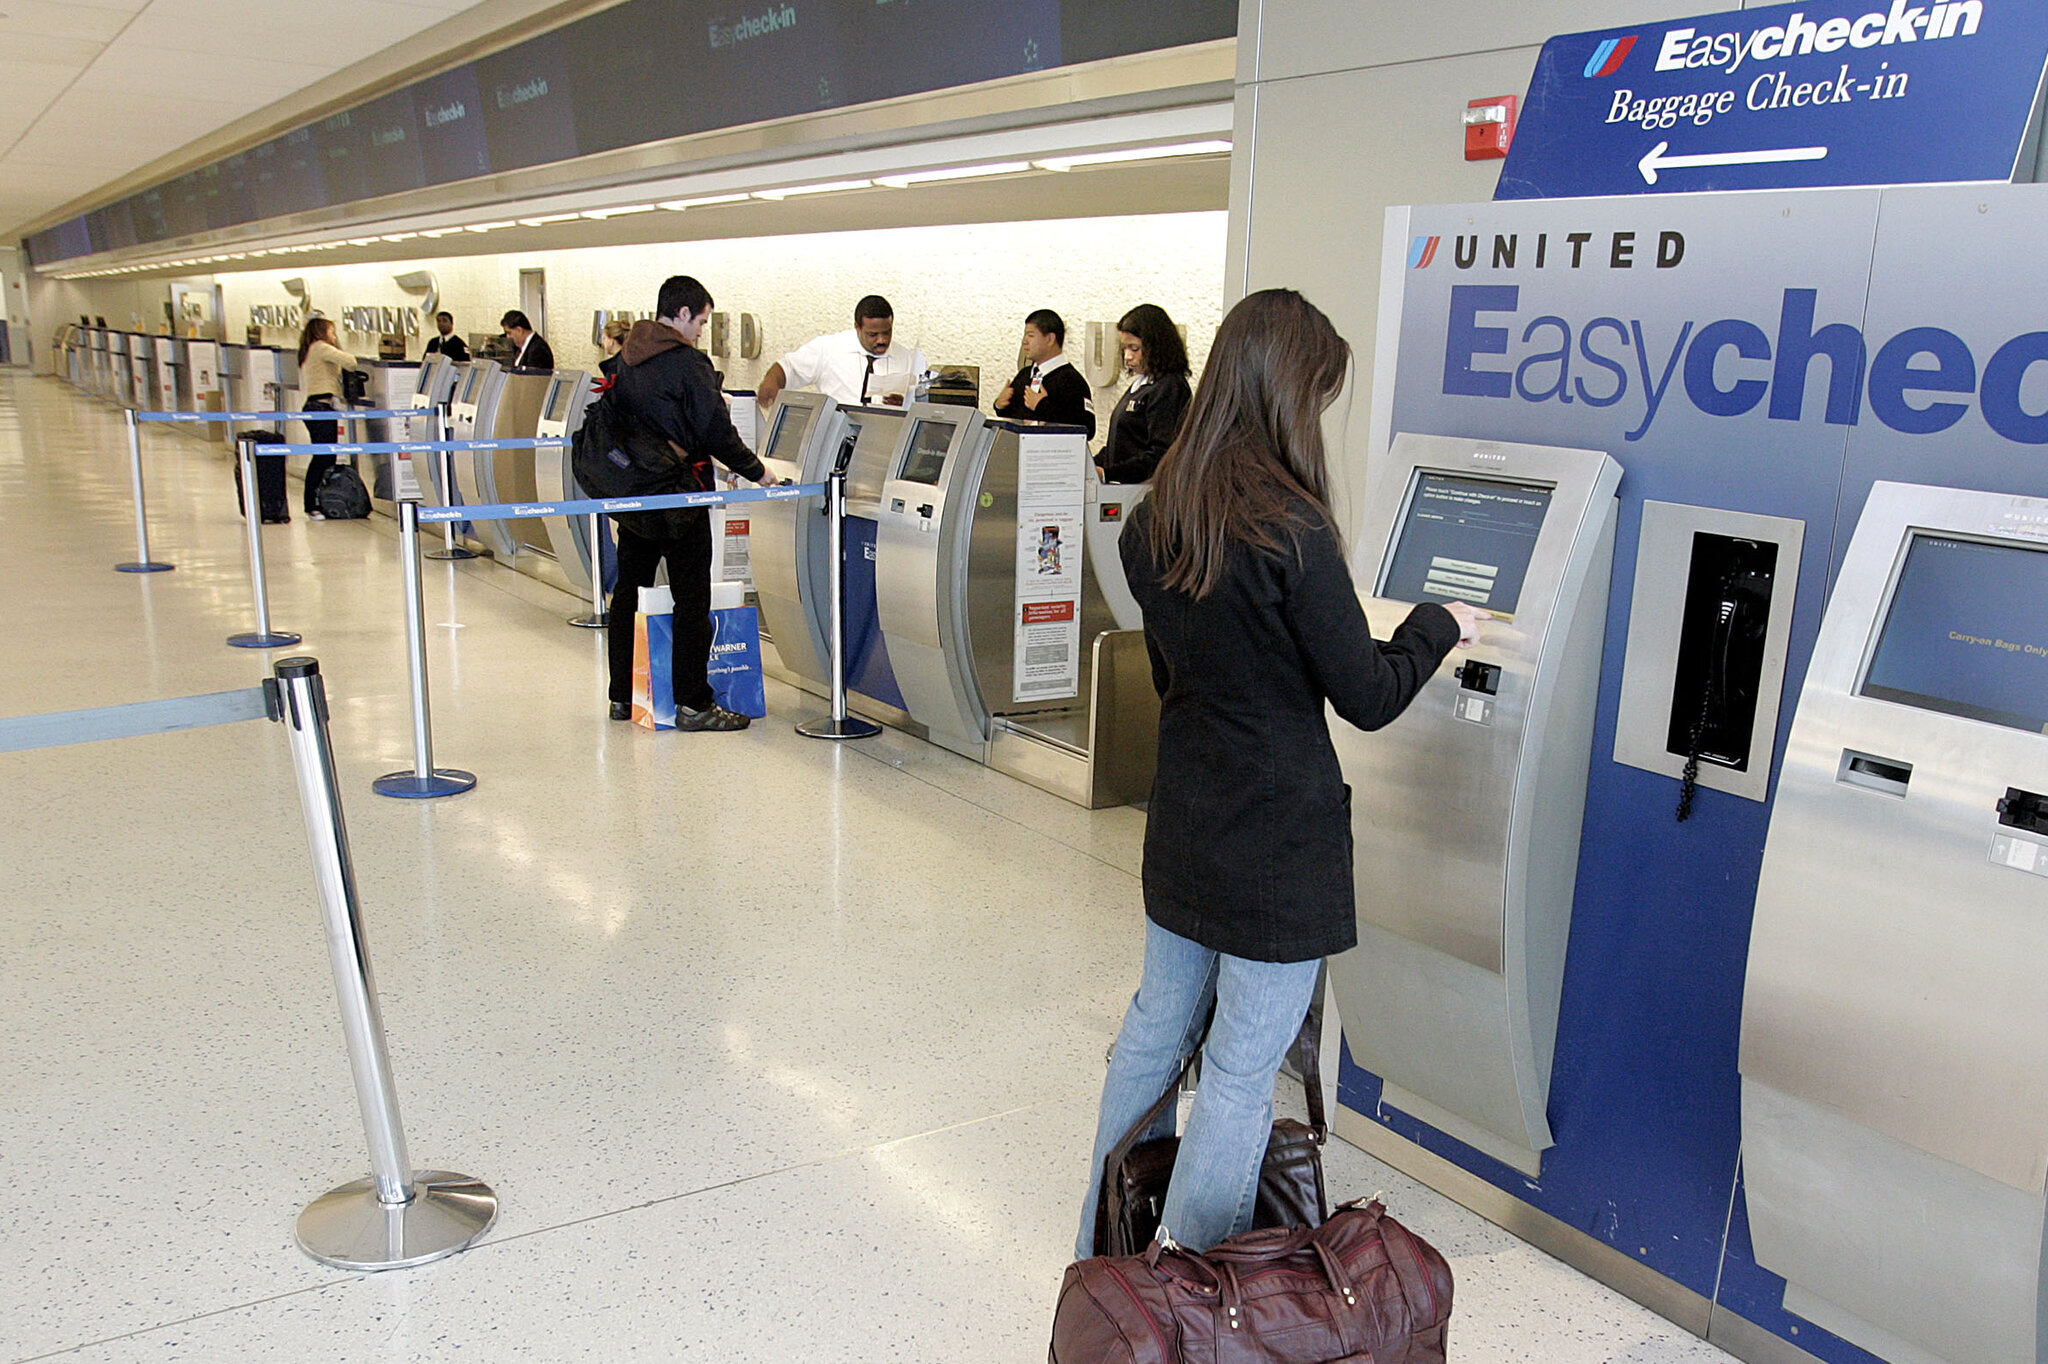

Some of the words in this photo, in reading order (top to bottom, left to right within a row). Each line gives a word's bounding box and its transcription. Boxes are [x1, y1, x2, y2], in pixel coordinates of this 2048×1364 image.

[1655, 0, 1984, 74] Easycheck-in
[1605, 89, 1736, 130] Baggage
[1746, 62, 1910, 111] Check-in
[1453, 229, 1687, 270] UNITED
[1948, 631, 1992, 645] Carry-on
[1994, 639, 2021, 652] Bags
[2024, 644, 2048, 657] Only
